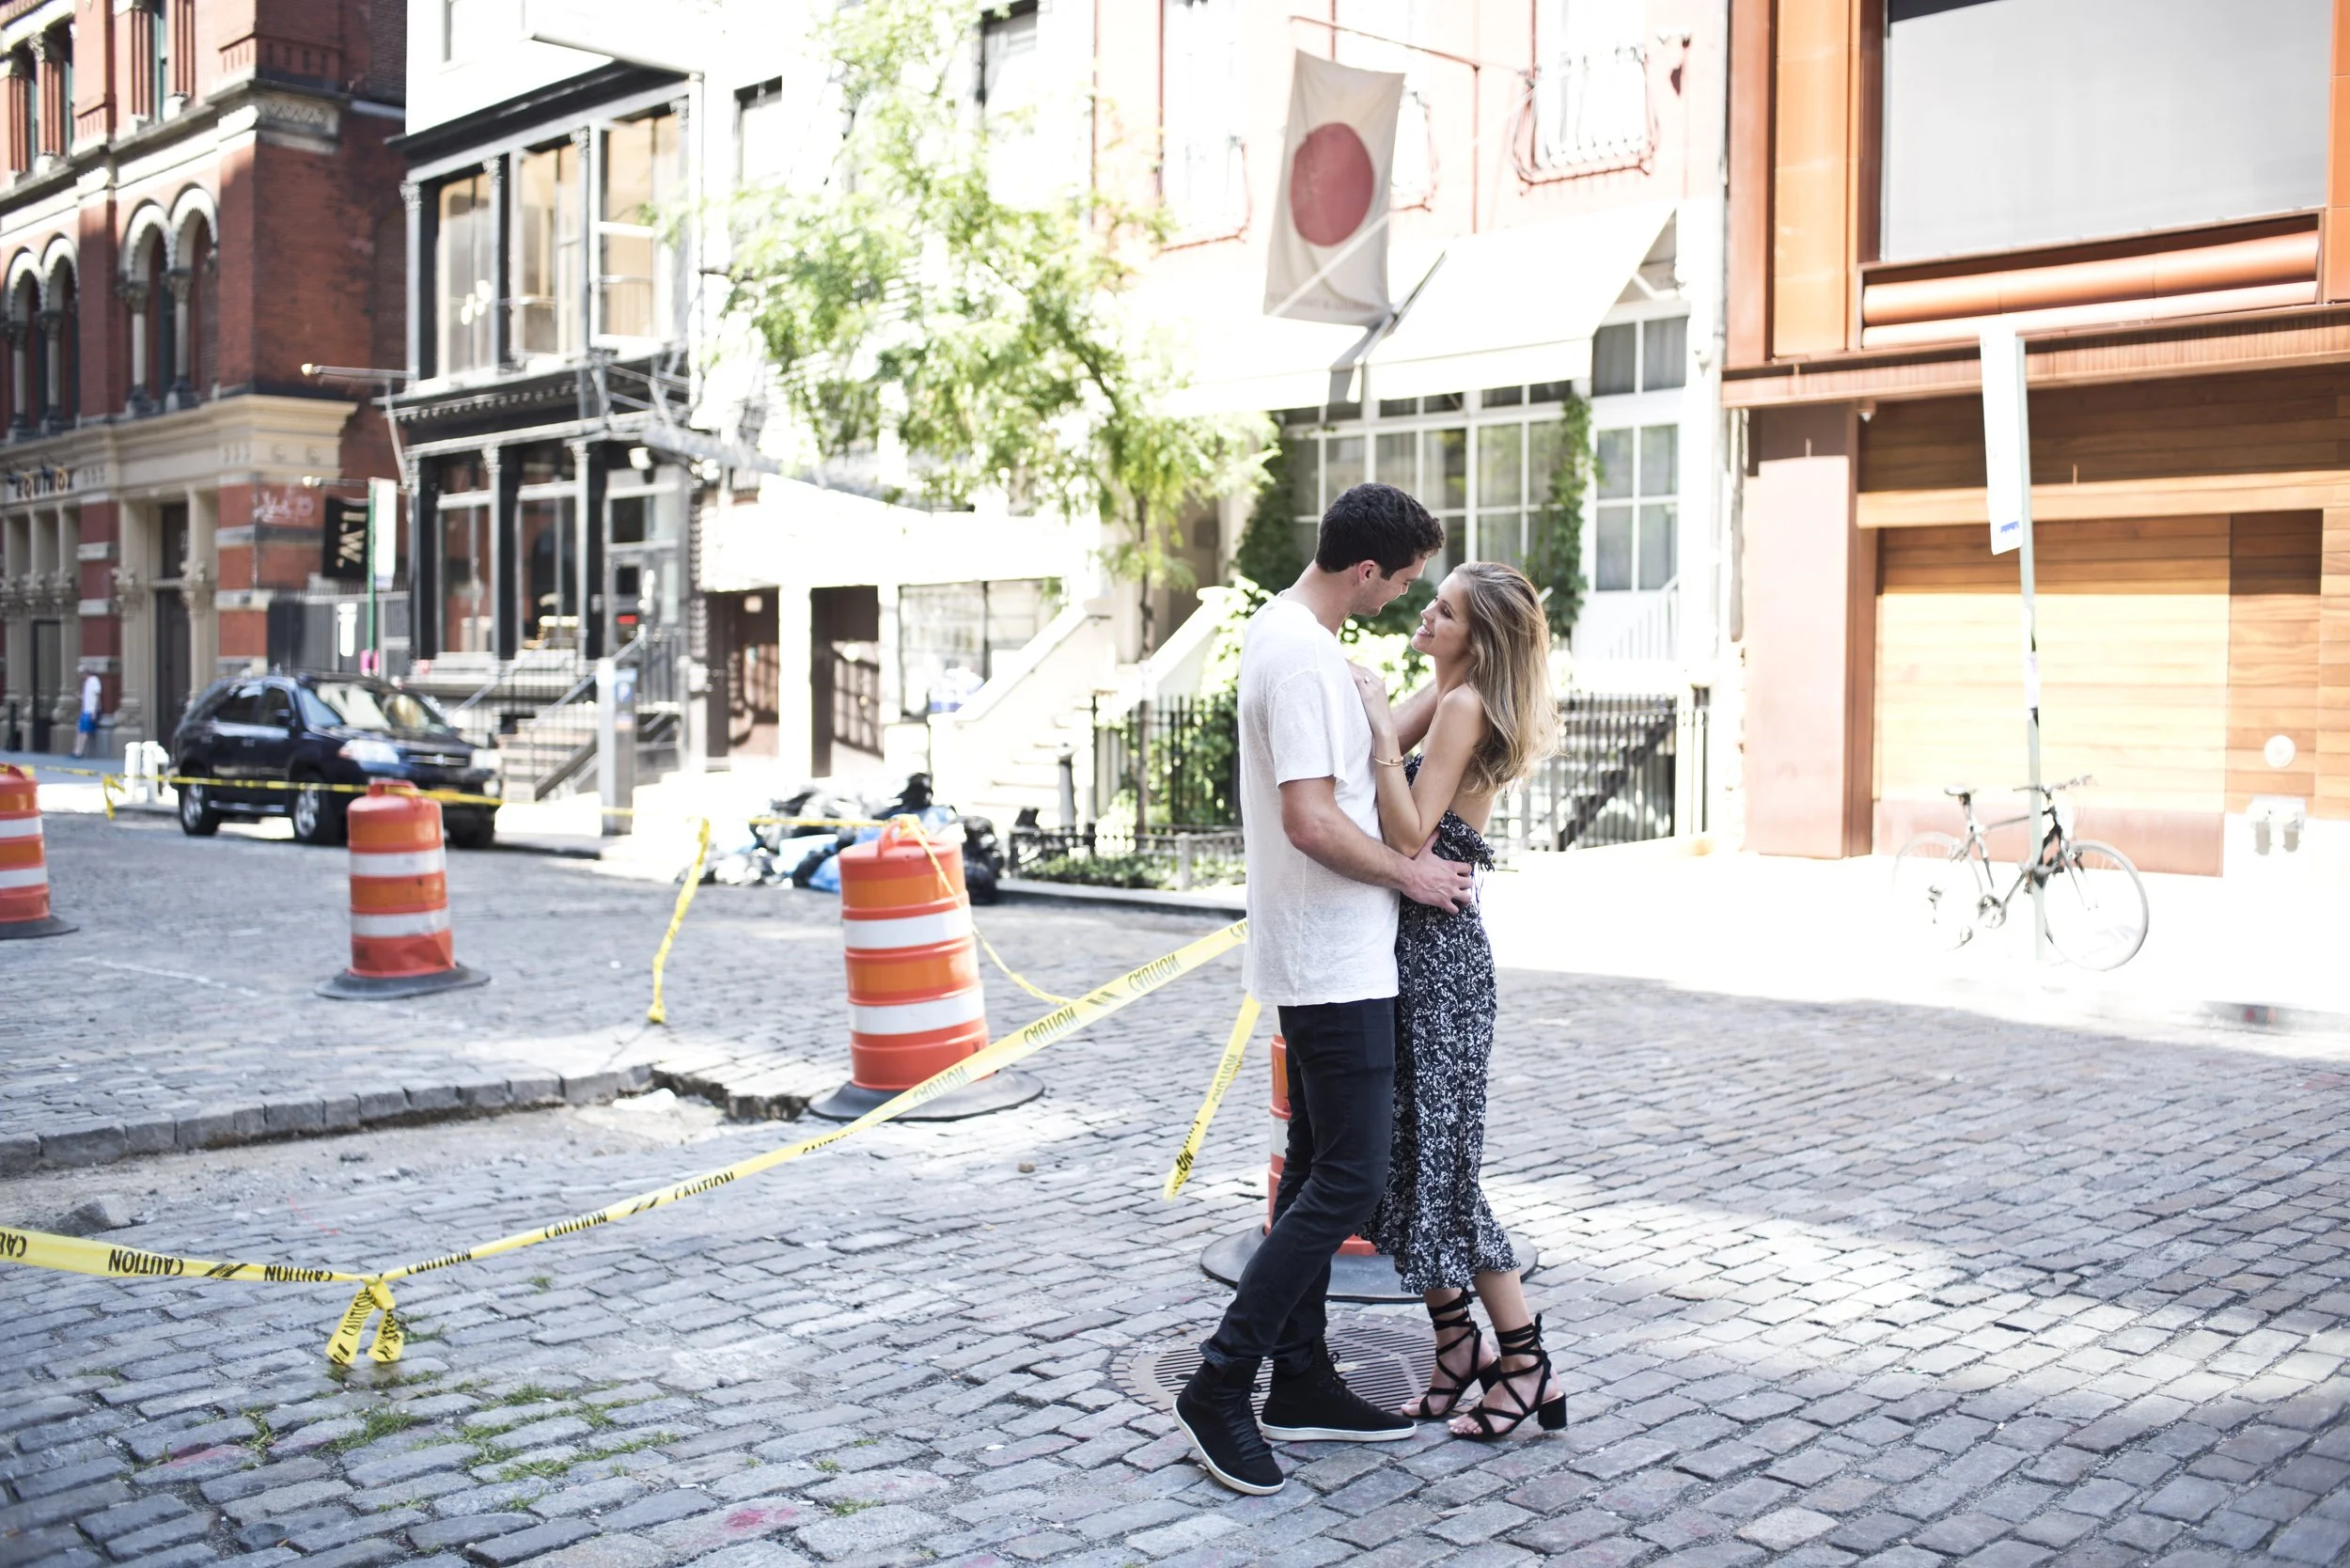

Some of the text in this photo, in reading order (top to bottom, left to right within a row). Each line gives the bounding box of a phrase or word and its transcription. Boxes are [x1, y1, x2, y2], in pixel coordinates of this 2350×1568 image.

[674, 1171, 734, 1200] CAUTION
[108, 1248, 184, 1276] CAUTION
[264, 1265, 333, 1282] CAUTION
